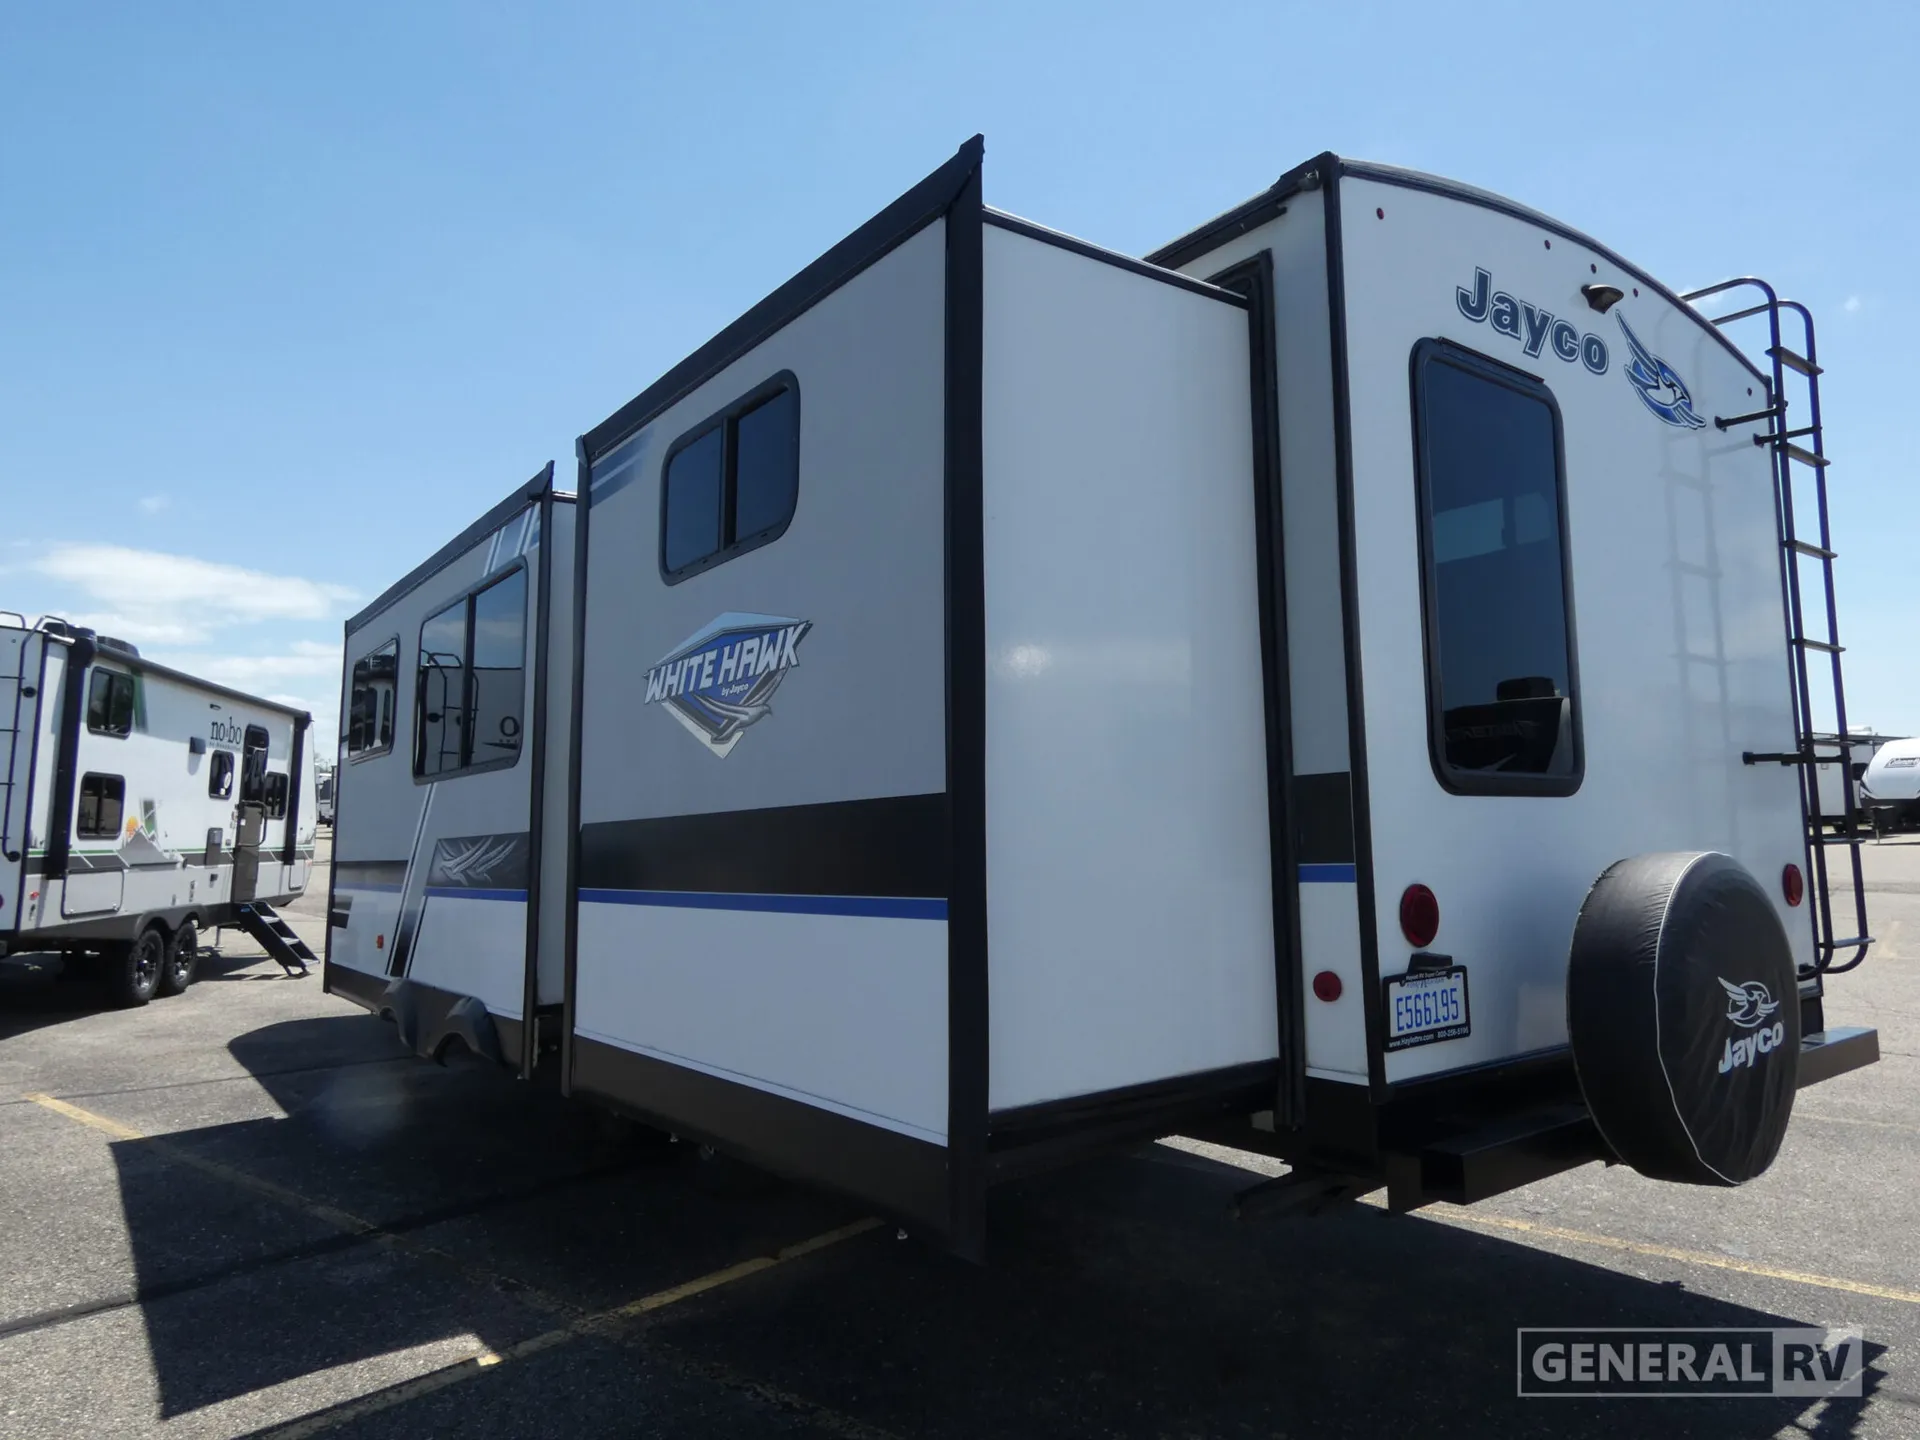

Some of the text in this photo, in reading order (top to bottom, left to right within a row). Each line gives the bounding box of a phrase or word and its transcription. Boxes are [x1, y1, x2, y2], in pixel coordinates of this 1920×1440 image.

[1456, 266, 1609, 376] Jayco
[644, 622, 809, 704] WHITE HAWK
[721, 683, 749, 697] by Jayco
[1396, 988, 1459, 1031] E566195
[1718, 1021, 1784, 1074] Jayco
